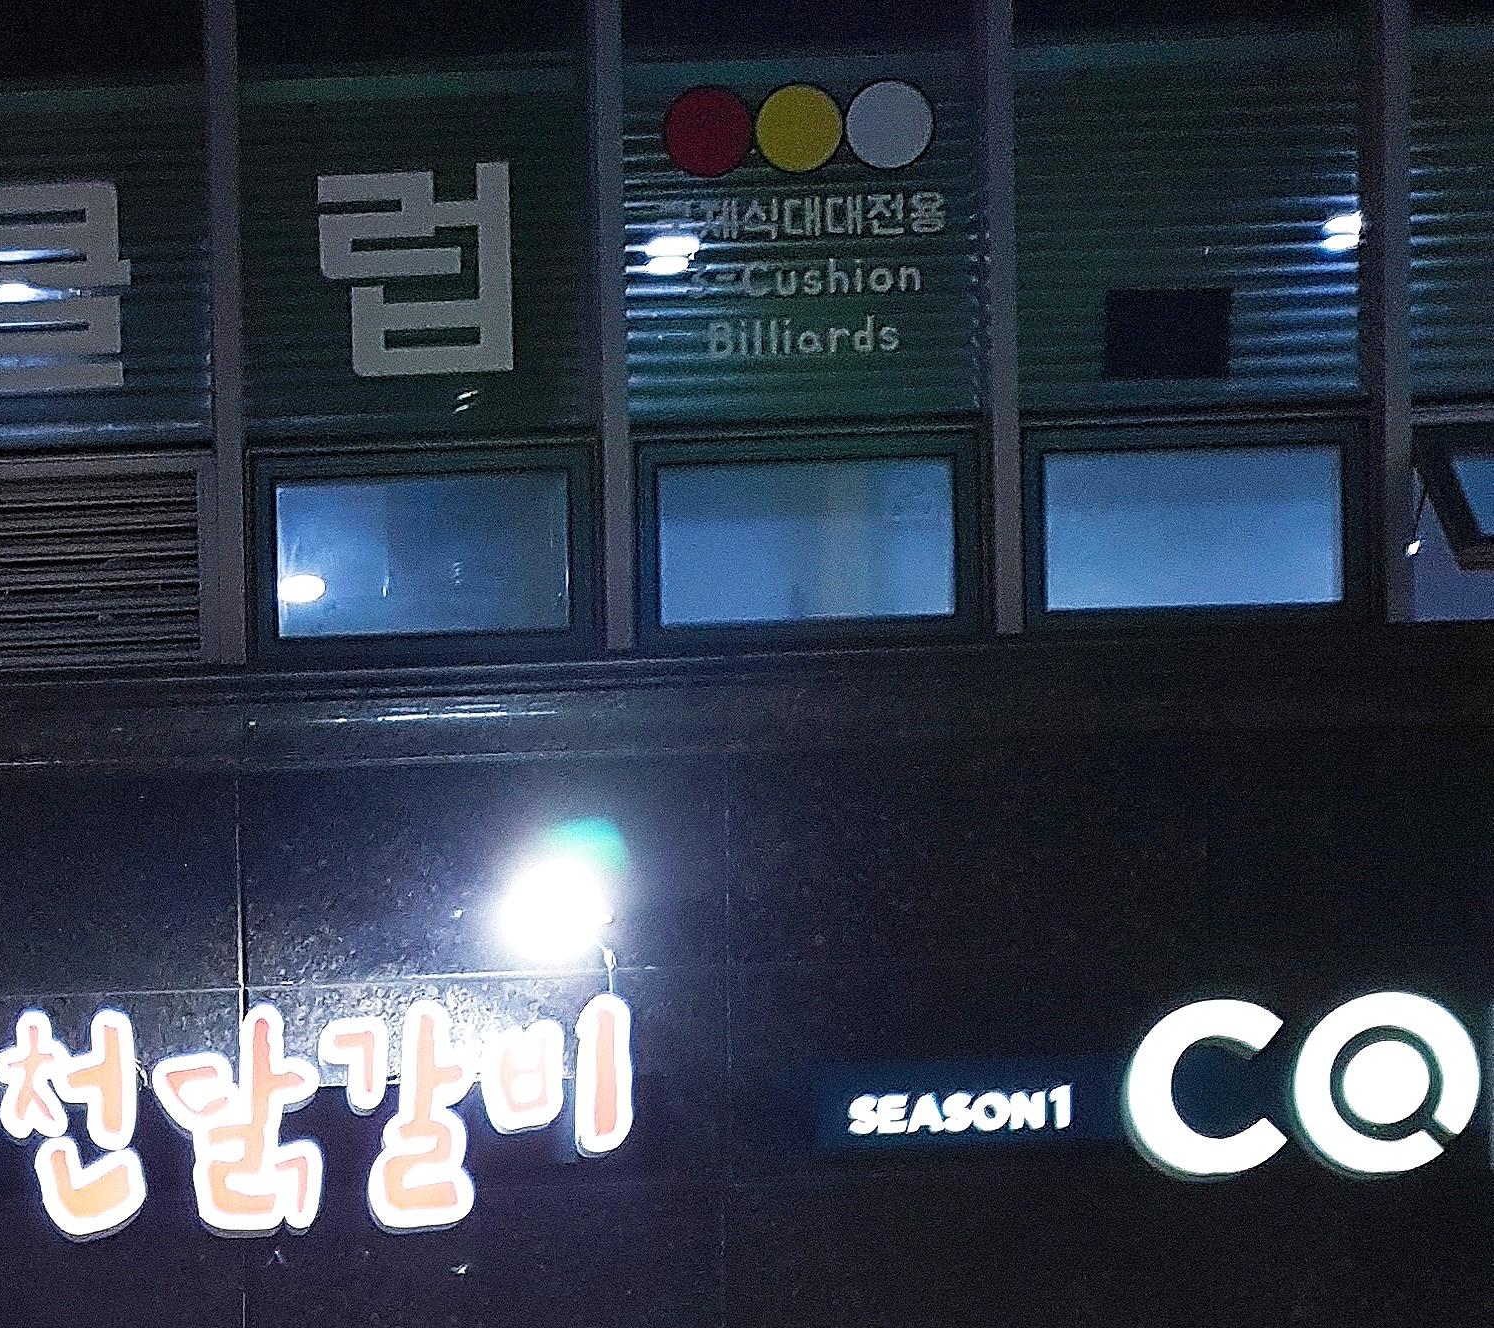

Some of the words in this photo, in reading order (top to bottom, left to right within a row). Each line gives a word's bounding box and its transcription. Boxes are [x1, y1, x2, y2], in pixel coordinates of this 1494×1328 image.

[706, 313, 900, 358] Billiards
[847, 1083, 1072, 1136] SEASON1
[1127, 990, 1494, 1178] CO
